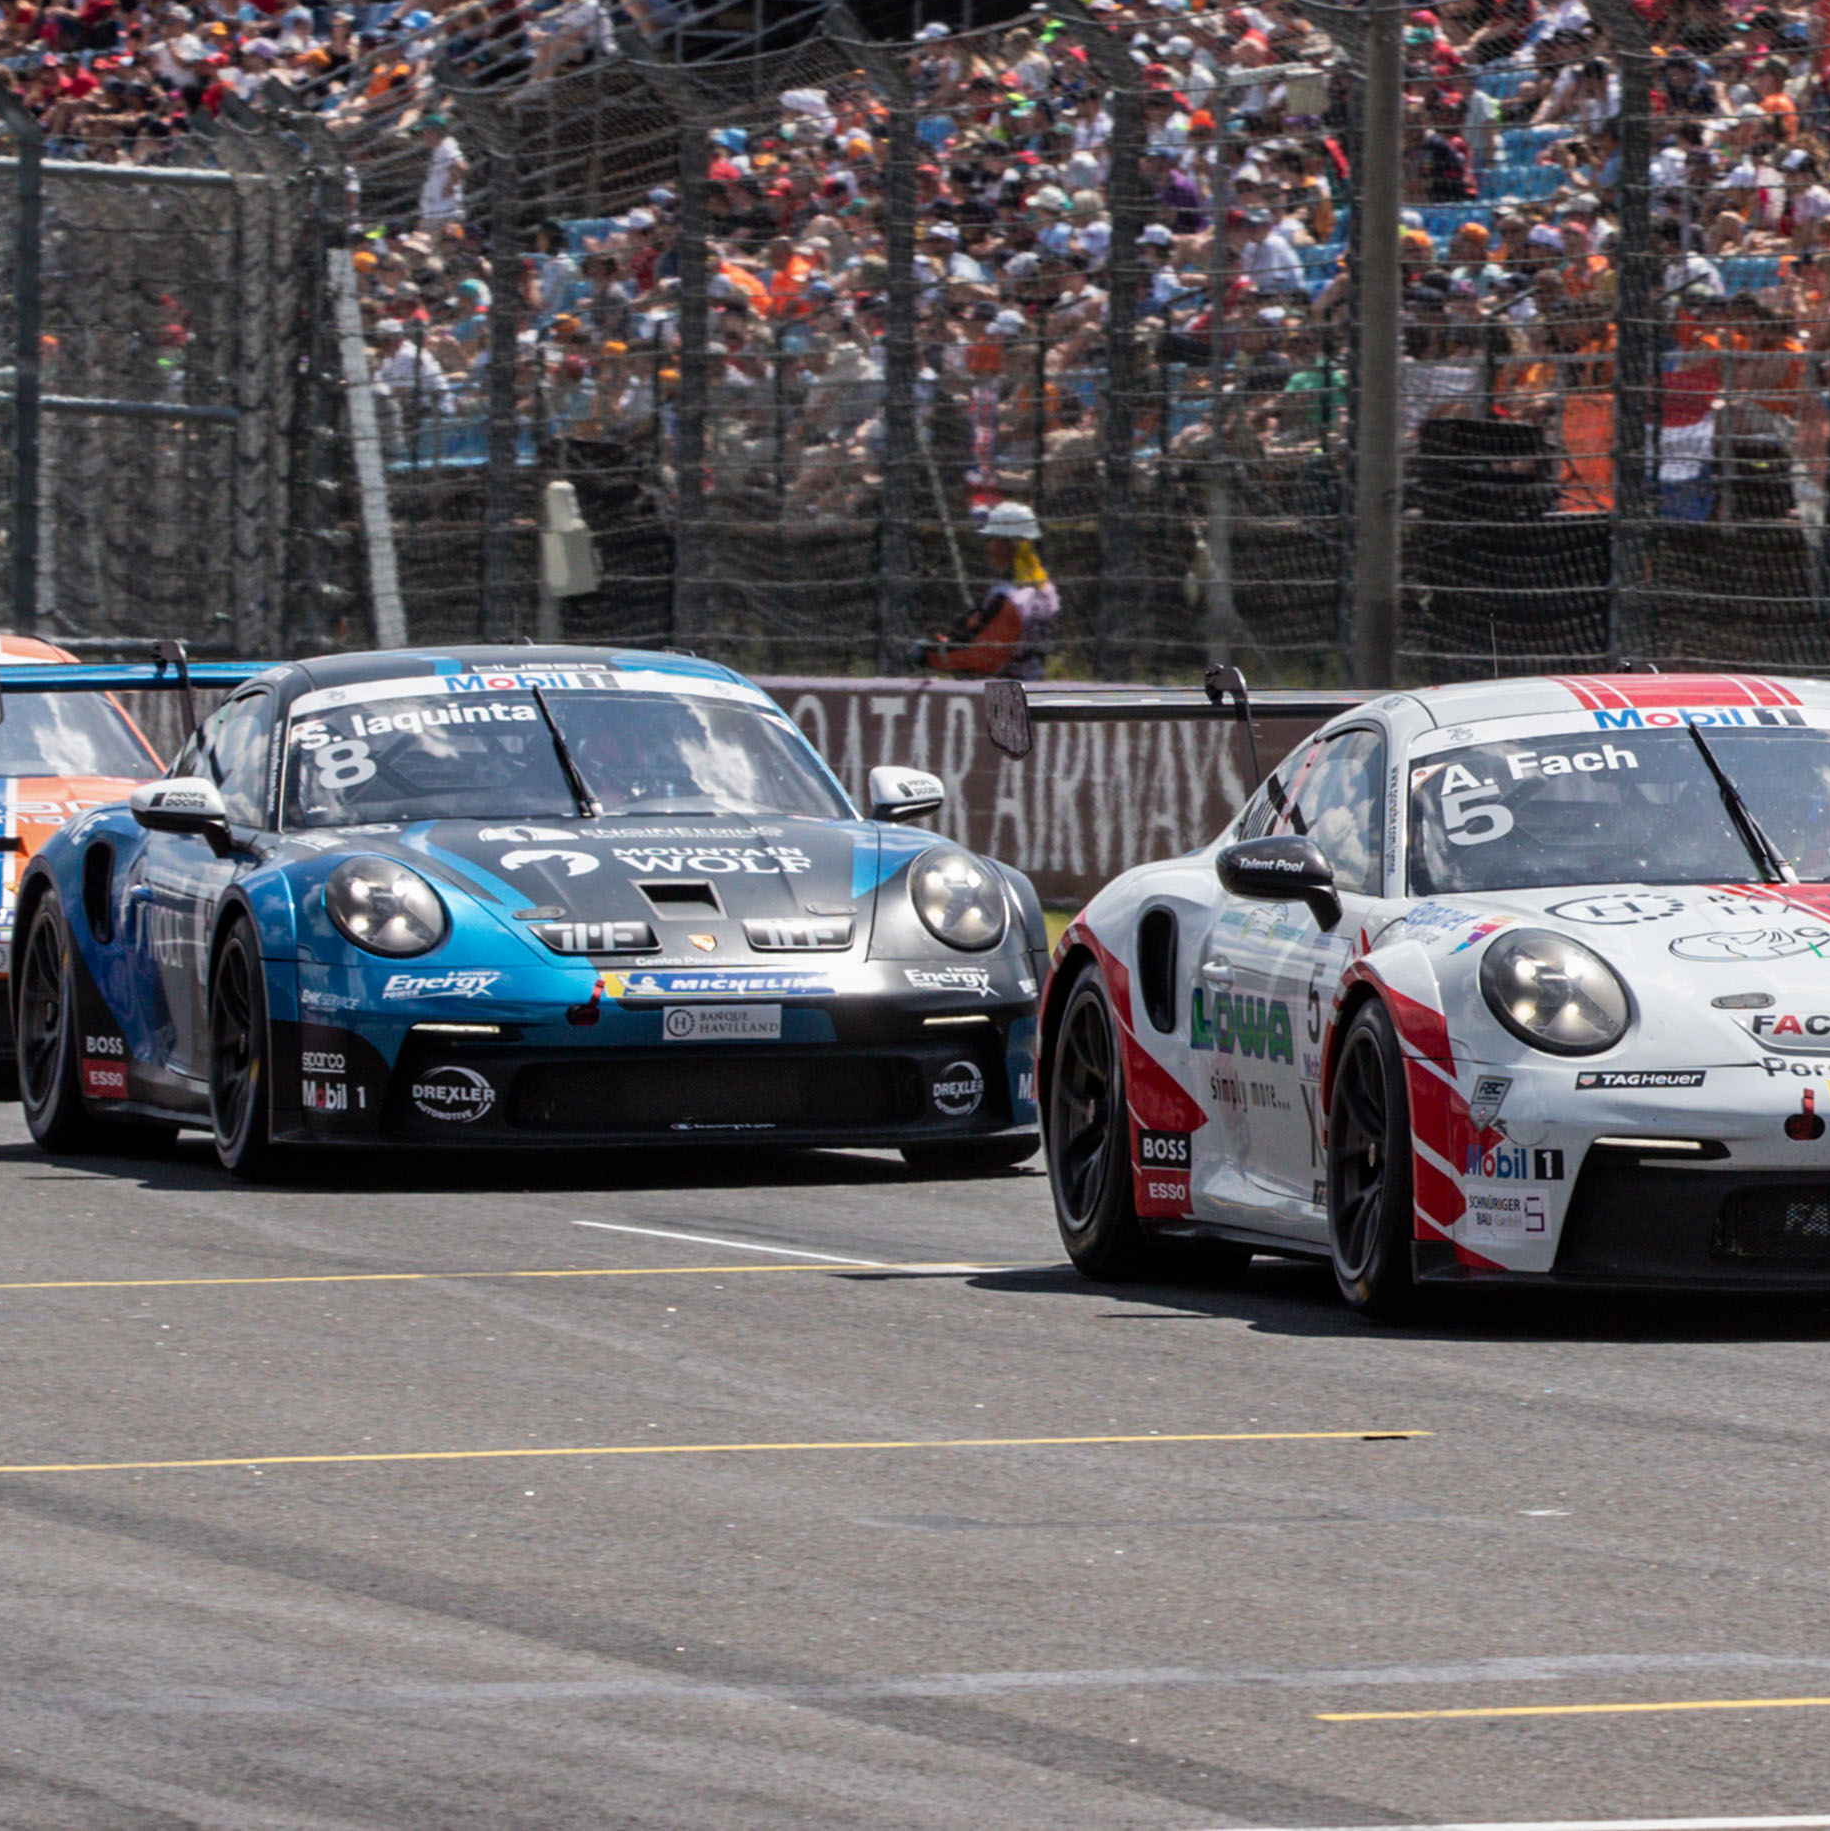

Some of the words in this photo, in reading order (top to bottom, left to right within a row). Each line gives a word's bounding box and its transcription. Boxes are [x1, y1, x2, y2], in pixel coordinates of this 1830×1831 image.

[444, 674, 570, 693] Mobil
[1593, 706, 1746, 730] Mobil
[299, 721, 343, 751] S.
[315, 740, 378, 790] 8
[1440, 763, 1496, 796] A.
[1506, 744, 1639, 781] Fach
[168, 790, 208, 800] PROFIL
[1440, 785, 1515, 847] 5
[612, 847, 804, 857] MOUNTAIN
[617, 855, 812, 874] WOLF
[1238, 857, 1274, 870] Talent
[1275, 859, 1305, 873] Pool
[635, 955, 681, 967] Centro
[386, 973, 501, 998] Energy
[670, 978, 813, 991] MICHELIN
[904, 968, 990, 988] Energy
[1307, 963, 1326, 1044] 5
[699, 1012, 749, 1023] BANQUE
[1190, 987, 1294, 1066] LOWA
[699, 1022, 779, 1035] HAVILLAND
[86, 1035, 123, 1055] BOSS
[301, 1052, 346, 1069] sparco
[89, 1070, 123, 1087] ESSO
[302, 1079, 348, 1110] Mobil
[356, 1085, 367, 1109] 1
[412, 1084, 496, 1104] DREXLER
[932, 1079, 985, 1100] DREXLER
[1210, 1071, 1248, 1113] simply
[1142, 1137, 1187, 1161] BOSS
[1467, 1143, 1528, 1179] Mobil
[1148, 1181, 1187, 1201] ESSO
[1468, 1195, 1521, 1211] SCHNÜRIGER
[1476, 1212, 1493, 1227] BAU
